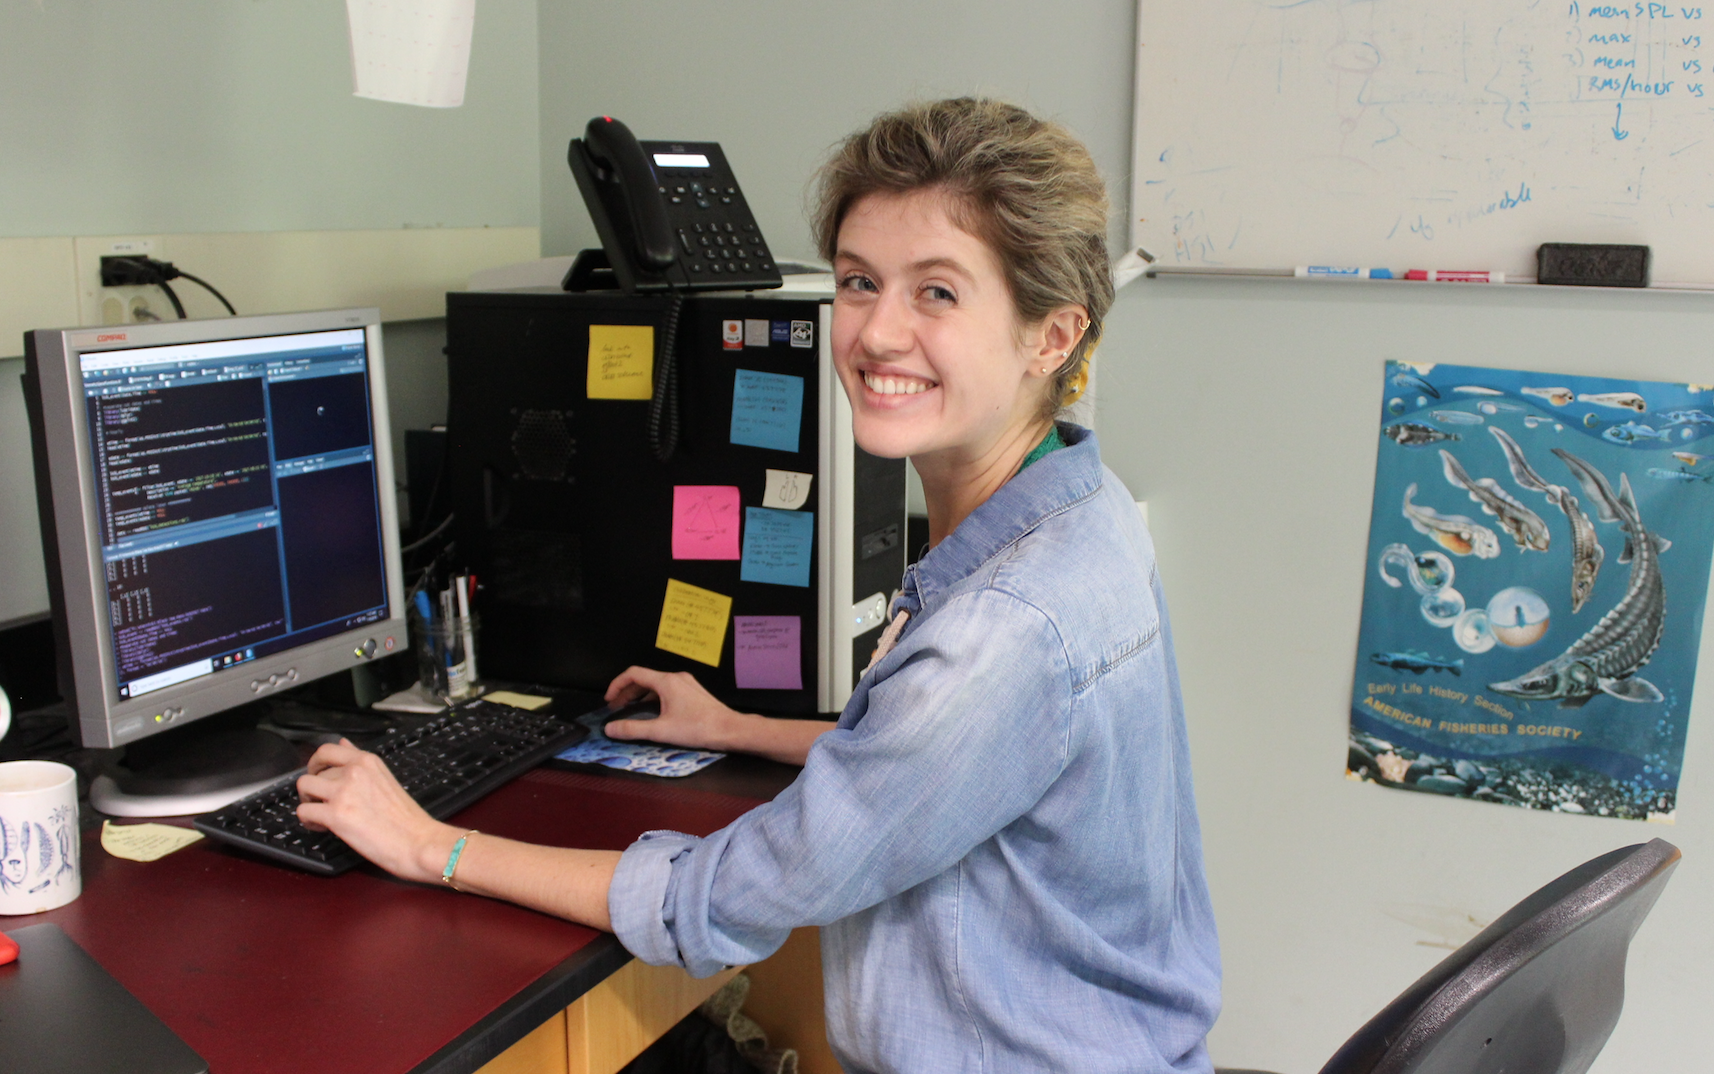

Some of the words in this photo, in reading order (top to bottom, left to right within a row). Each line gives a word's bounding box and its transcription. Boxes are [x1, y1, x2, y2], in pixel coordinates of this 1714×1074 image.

[1589, 6, 1630, 19] mean
[1635, 2, 1674, 19] SPL
[1588, 33, 1631, 44] max
[1368, 682, 1396, 695] Early
[1402, 682, 1423, 694] Life
[1429, 685, 1469, 705] History
[1474, 694, 1514, 721] Section
[1363, 695, 1432, 729] AMERICAN
[1439, 721, 1509, 736] FISHERIES
[1517, 724, 1583, 741] SOCIETY
